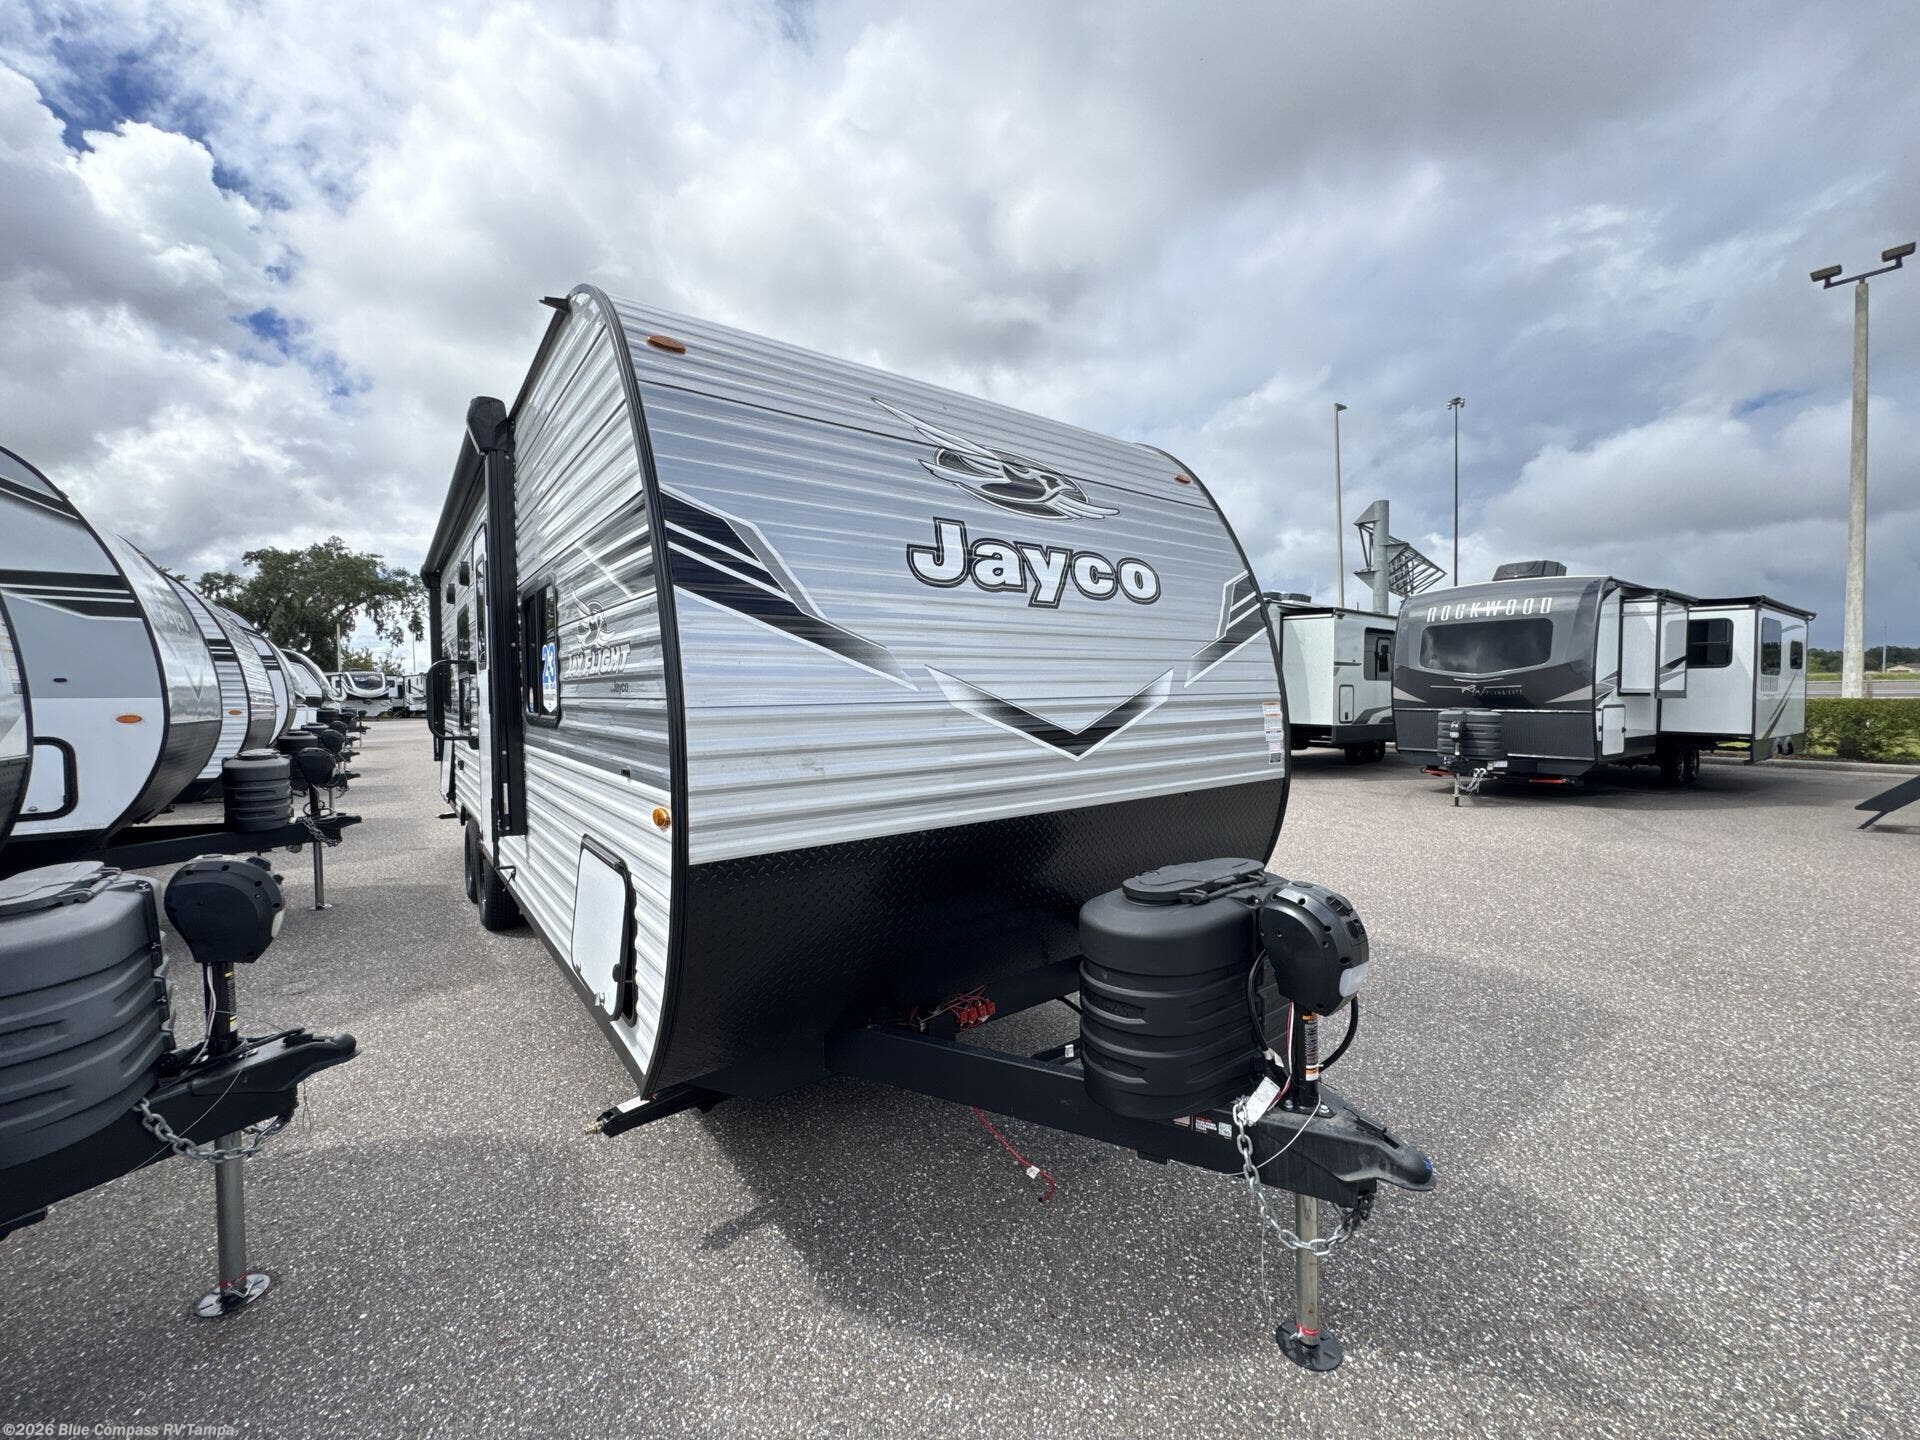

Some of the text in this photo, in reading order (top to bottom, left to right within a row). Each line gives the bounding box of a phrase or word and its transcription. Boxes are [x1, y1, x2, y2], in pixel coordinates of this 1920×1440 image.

[906, 516, 1161, 609] Jayco
[1427, 597, 1553, 623] ROCKWOOD
[541, 642, 556, 683] 23
[584, 641, 631, 676] FLIGHT
